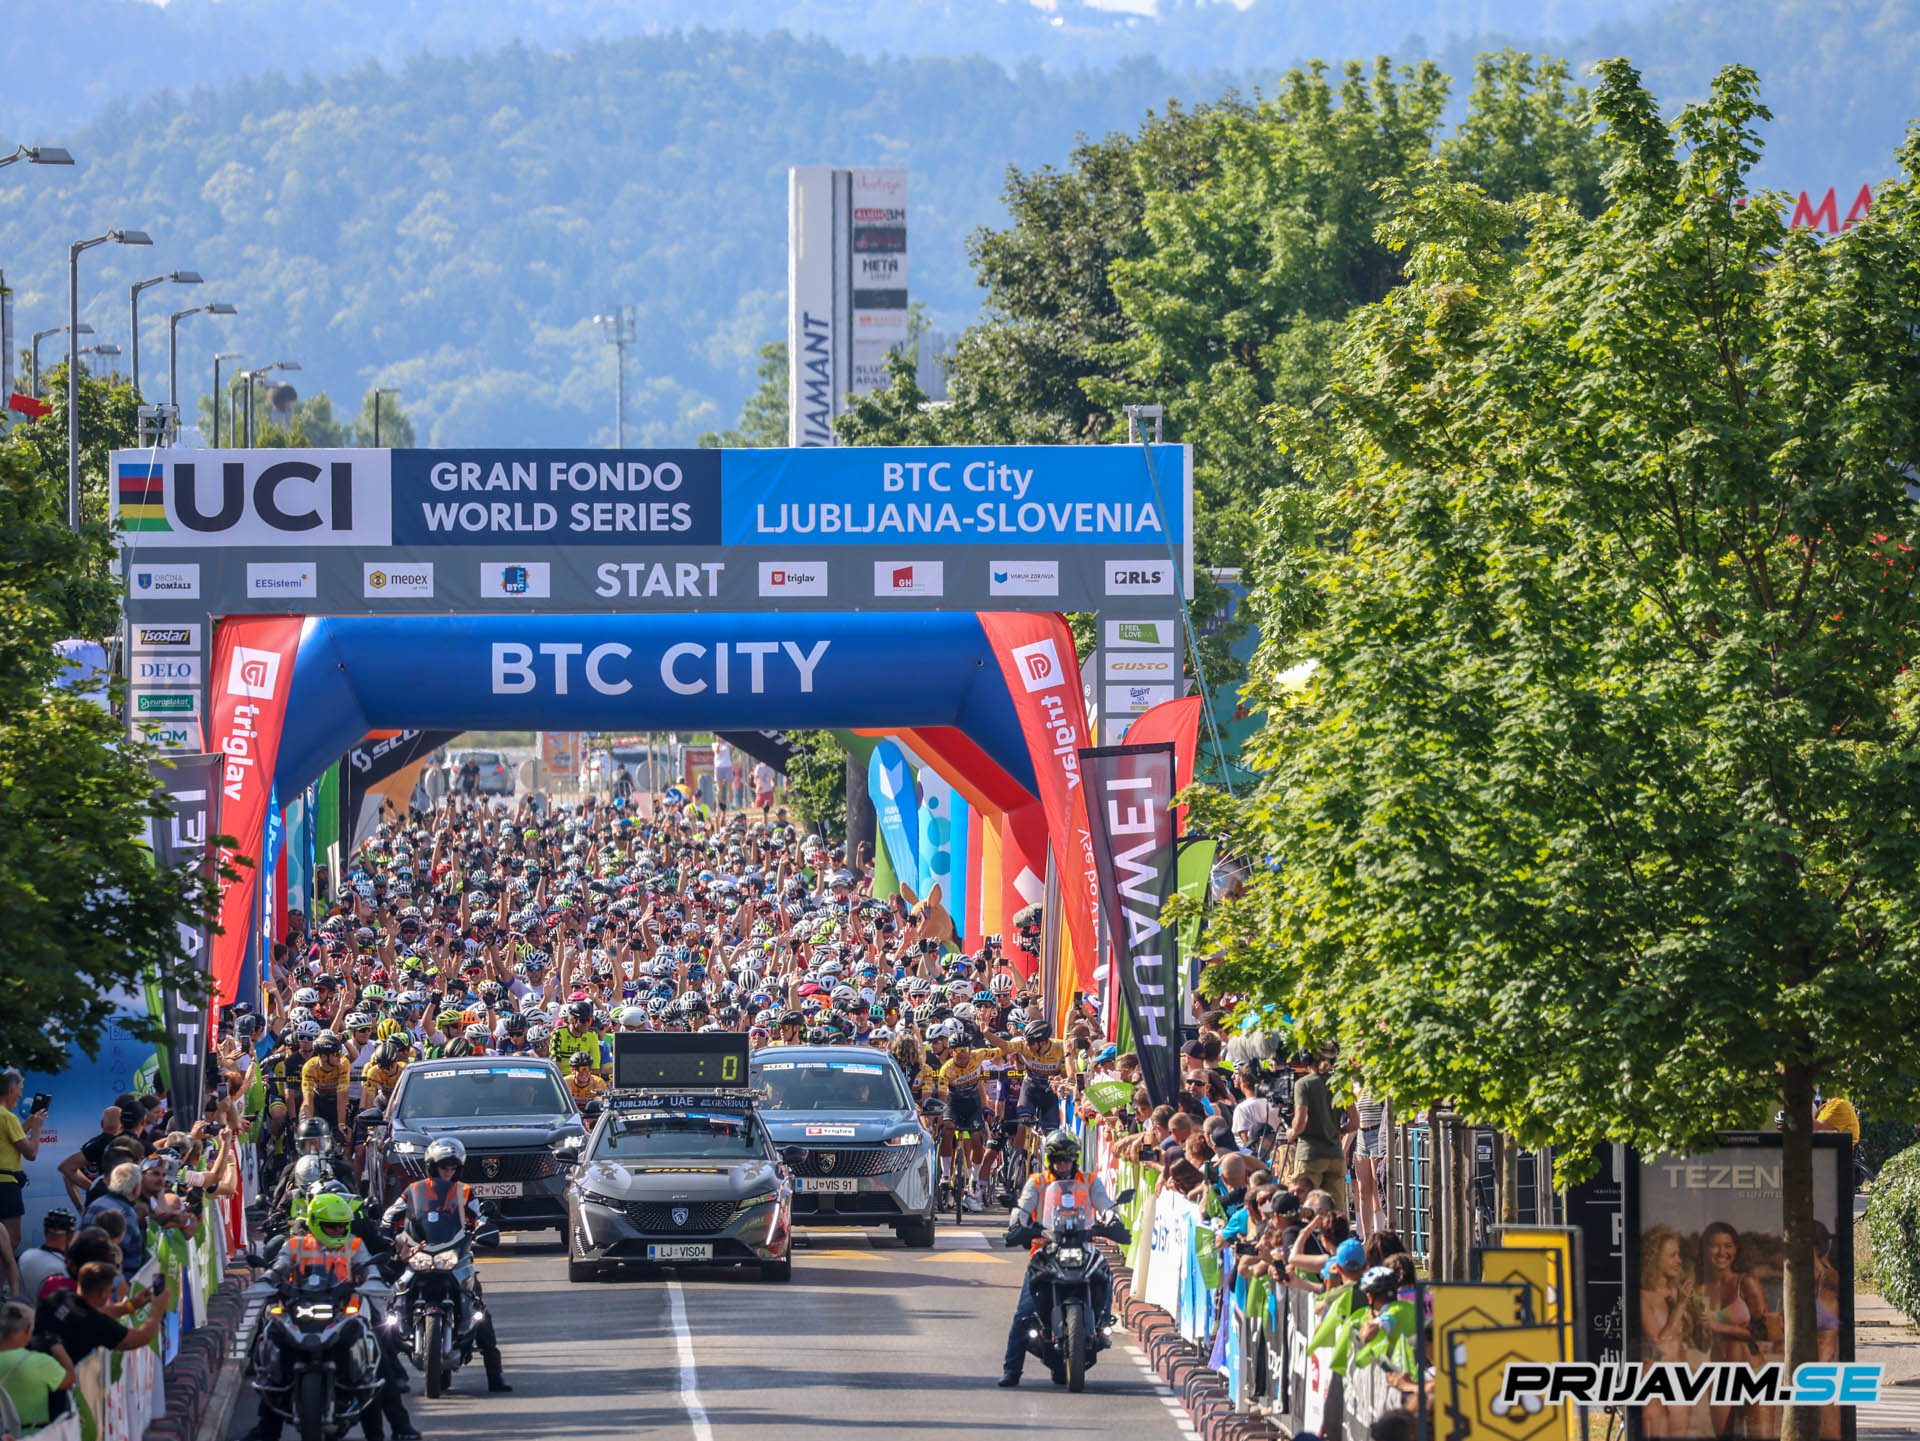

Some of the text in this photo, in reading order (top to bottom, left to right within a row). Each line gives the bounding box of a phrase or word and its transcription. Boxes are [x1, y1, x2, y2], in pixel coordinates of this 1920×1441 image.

[803, 312, 829, 447] IAMANT
[430, 462, 682, 491] GRAN FONDO
[883, 460, 1033, 500] BTC City
[173, 461, 352, 532] UCI
[422, 502, 692, 532] WORLD SERIES
[757, 502, 1162, 533] LJUBLJANA-SLOVENIA
[255, 577, 302, 588] EESistemi
[595, 563, 725, 597] START
[787, 573, 815, 585] triglav
[898, 578, 913, 587] GH
[1128, 571, 1162, 584] RLS
[155, 581, 192, 590] DOMŽALE
[143, 629, 185, 642] isostar
[141, 663, 192, 678] DELO
[492, 640, 832, 696] BTC CITY
[1111, 662, 1169, 671] GUSTO
[146, 730, 187, 741] MDM
[222, 704, 261, 801] triglav
[613, 1096, 749, 1108] LJUBLJANA UAE GENERALI
[1663, 1164, 1783, 1189] TEZEN
[472, 1183, 517, 1195] KR VIS20
[806, 1180, 852, 1191] LJ VIS 91
[660, 1246, 706, 1257] LJ VIS04
